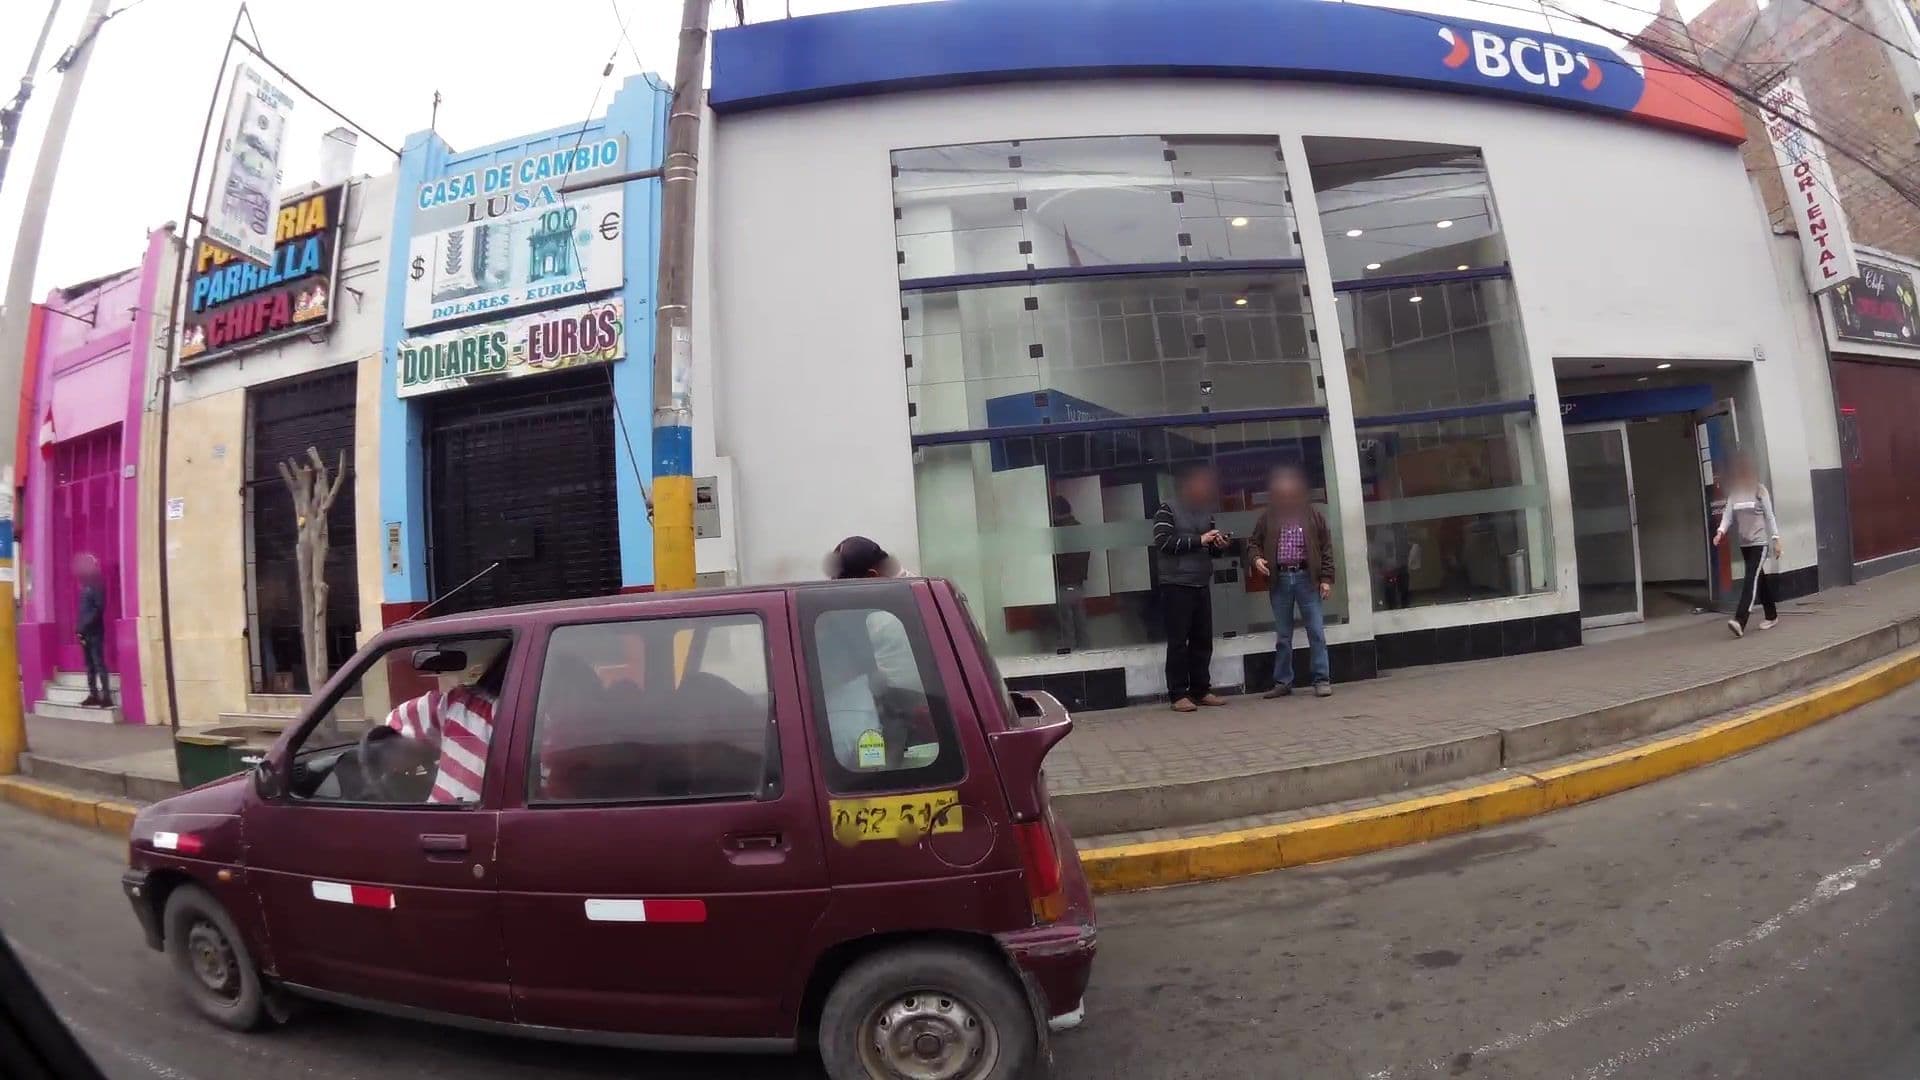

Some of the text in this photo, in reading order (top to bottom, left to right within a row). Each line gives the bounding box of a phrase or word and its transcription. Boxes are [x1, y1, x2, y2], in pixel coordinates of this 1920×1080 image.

[1472, 30, 1575, 87] BCP
[419, 139, 619, 209] CASA DE CAMBIO
[466, 185, 559, 223] LUSA
[197, 195, 327, 272] PORIA
[1793, 161, 1838, 280] ORIENTAL
[191, 238, 320, 312] PARRILLA
[432, 294, 510, 320] DOLARES
[526, 281, 587, 300] EUROS
[207, 290, 292, 346] CHIFA
[402, 330, 509, 386] DOLARES
[527, 308, 618, 364] EUROS
